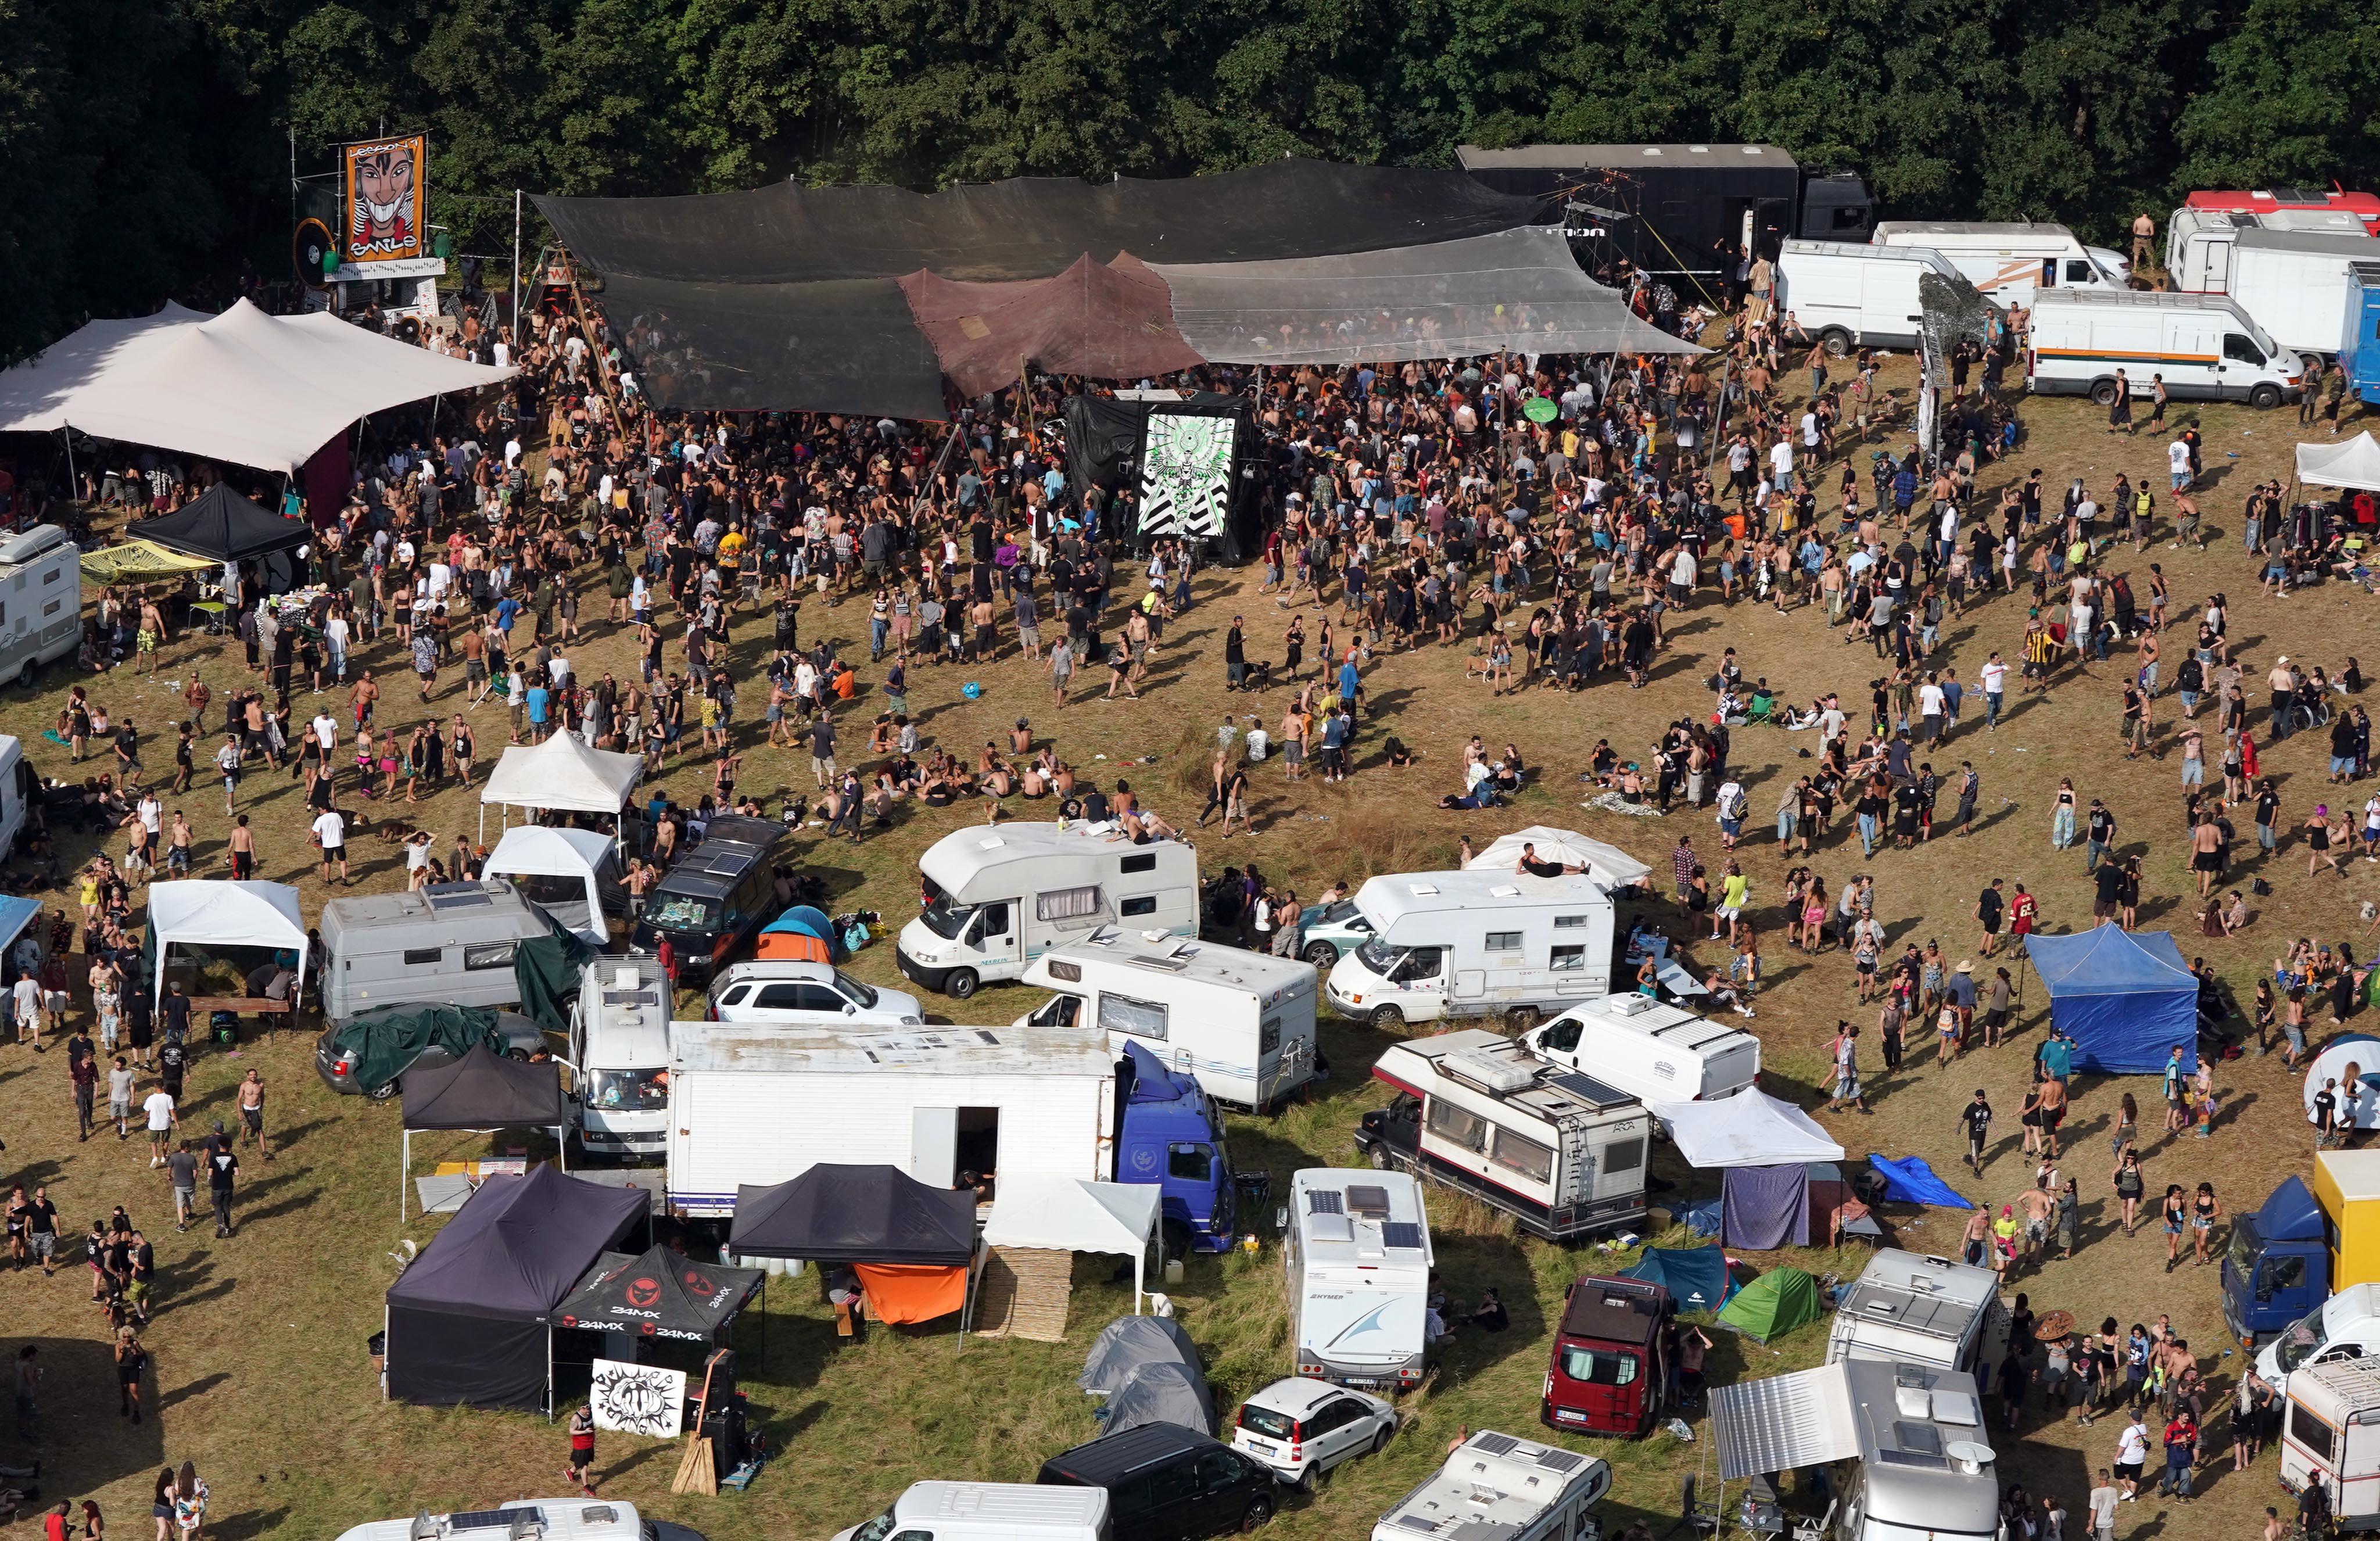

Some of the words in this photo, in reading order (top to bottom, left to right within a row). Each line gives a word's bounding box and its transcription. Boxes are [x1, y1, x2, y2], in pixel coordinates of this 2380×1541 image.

[1613, 1121, 1635, 1133] ARCA
[708, 1286, 733, 1309] 24MX
[610, 1306, 661, 1320] 24MX
[578, 1320, 625, 1331] 24MX
[657, 1328, 702, 1342] 24MX
